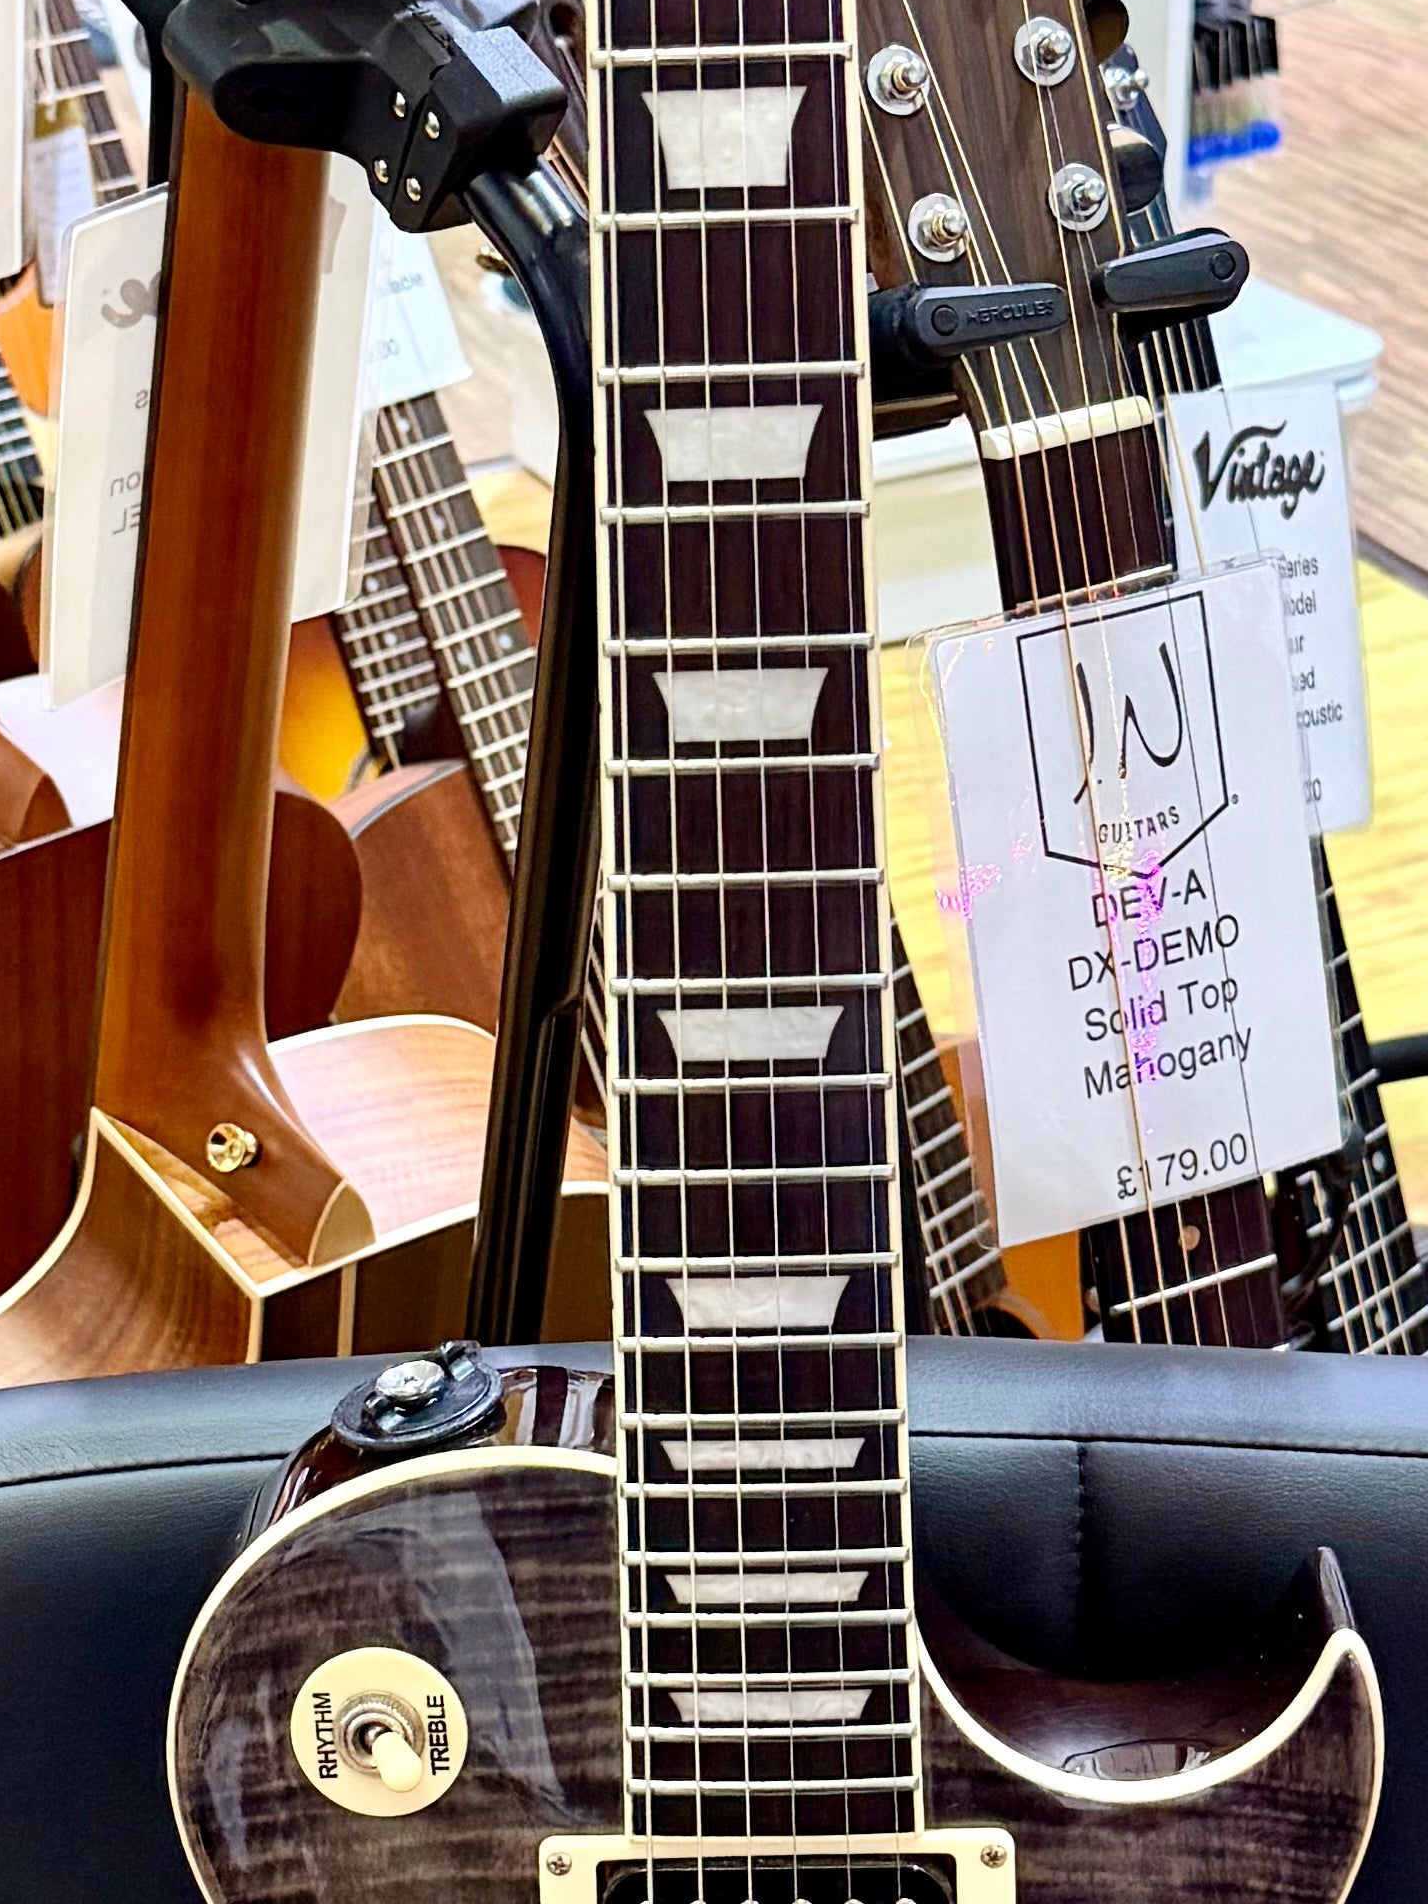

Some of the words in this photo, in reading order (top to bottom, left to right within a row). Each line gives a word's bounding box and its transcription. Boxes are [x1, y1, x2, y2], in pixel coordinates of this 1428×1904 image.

[1192, 418, 1327, 520] Vintage
[1295, 698, 1343, 730] coustic
[1098, 804, 1181, 845] GUITARS
[1091, 867, 1207, 928] DEV-A
[1068, 913, 1240, 992] DX-DEMO
[1084, 989, 1168, 1042] Solid
[1178, 976, 1239, 1018] Top
[1084, 1025, 1253, 1100] Mahogany
[1116, 1131, 1250, 1201] £179.00
[312, 1692, 338, 1779] RHYTHM
[426, 1694, 450, 1776] TREBLE
